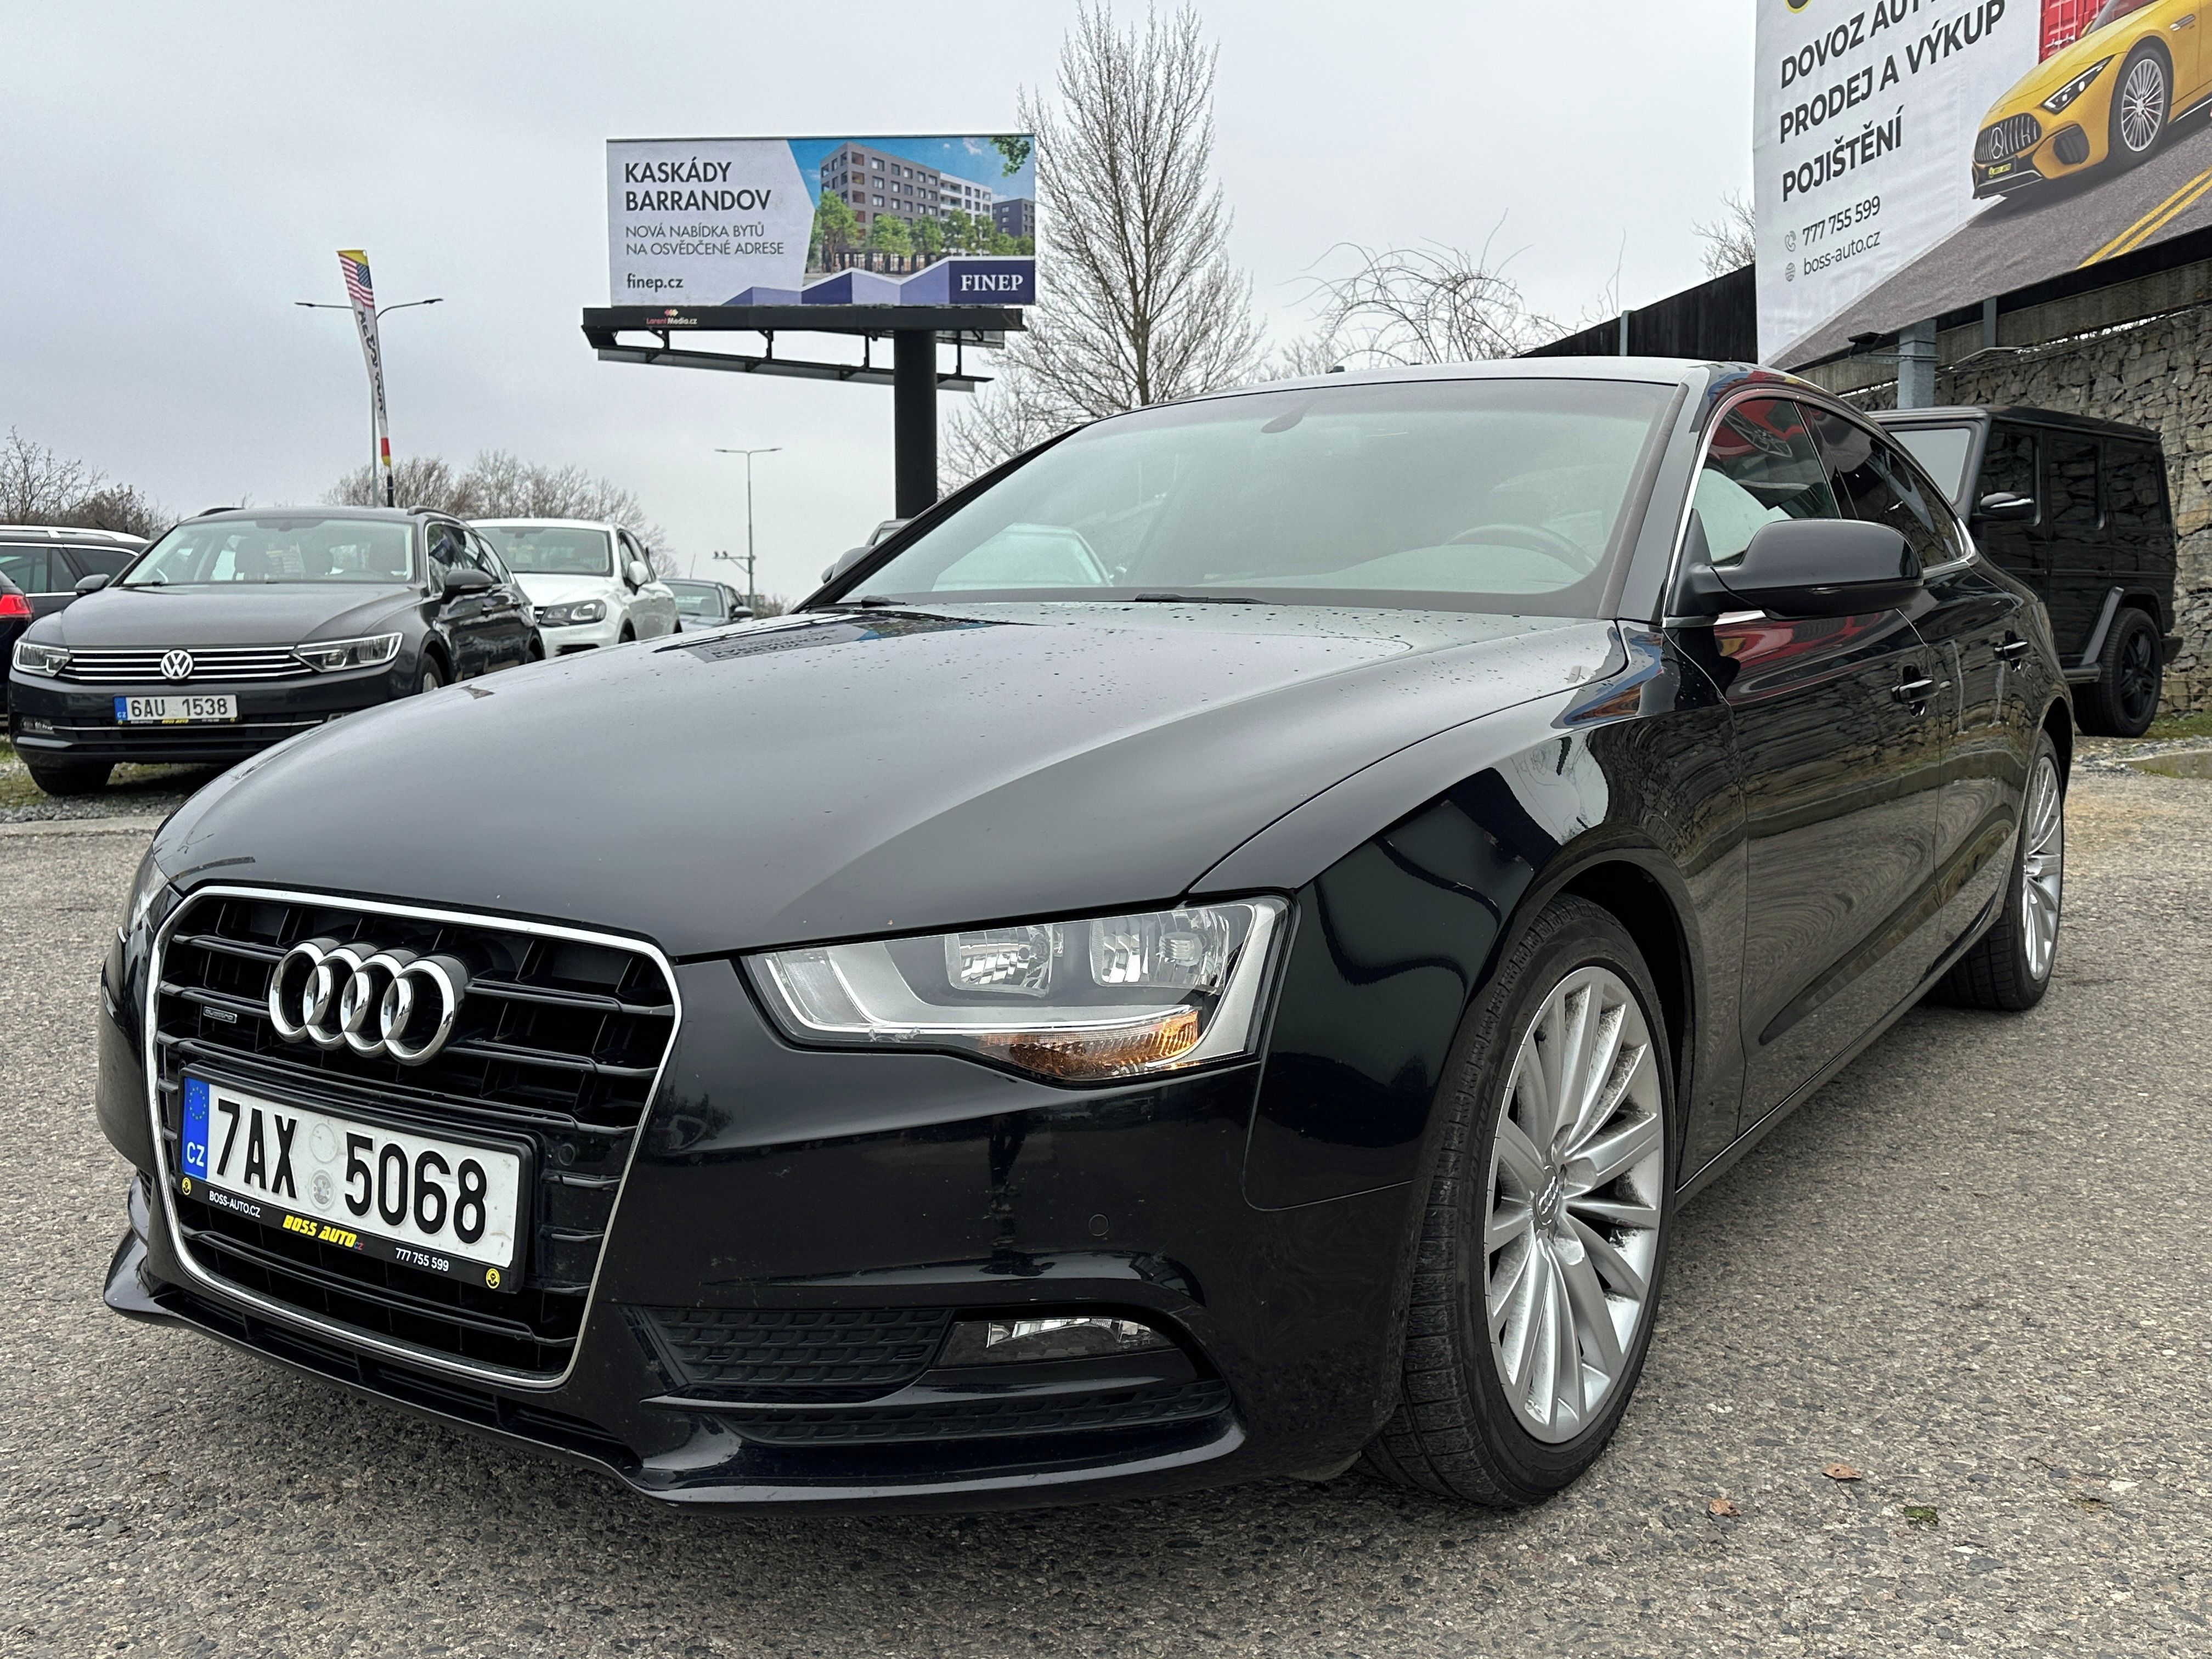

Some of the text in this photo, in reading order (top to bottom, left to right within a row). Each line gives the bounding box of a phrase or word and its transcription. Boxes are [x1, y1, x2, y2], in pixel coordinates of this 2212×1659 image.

[1781, 0, 1937, 89] DOVOZ AU
[1780, 0, 2006, 144] PRODEJ A VÝKUP
[1782, 104, 1904, 202] POJIŠTĚNÍ
[625, 156, 732, 183] KASKÁDY
[625, 189, 771, 211] BARRANDOV
[625, 222, 764, 238] NOVÁ NABÍDKA BYTŮ
[1803, 195, 1881, 246] 777 755 599
[626, 240, 784, 255] NA OSVĚDČENÉ ADRESE
[1804, 231, 1881, 276] boss-auto.cz
[627, 273, 683, 292] finep.cz
[961, 274, 1024, 291] FINEP
[131, 699, 165, 717] 6AU
[182, 698, 228, 716] 1538
[187, 1098, 487, 1244] CZ 7AX 5068
[209, 1190, 261, 1218] BOSS-AUTO.CZ
[283, 1215, 317, 1236] BOSS
[318, 1225, 357, 1248] AUTO
[396, 1248, 449, 1272] 777 755 599
